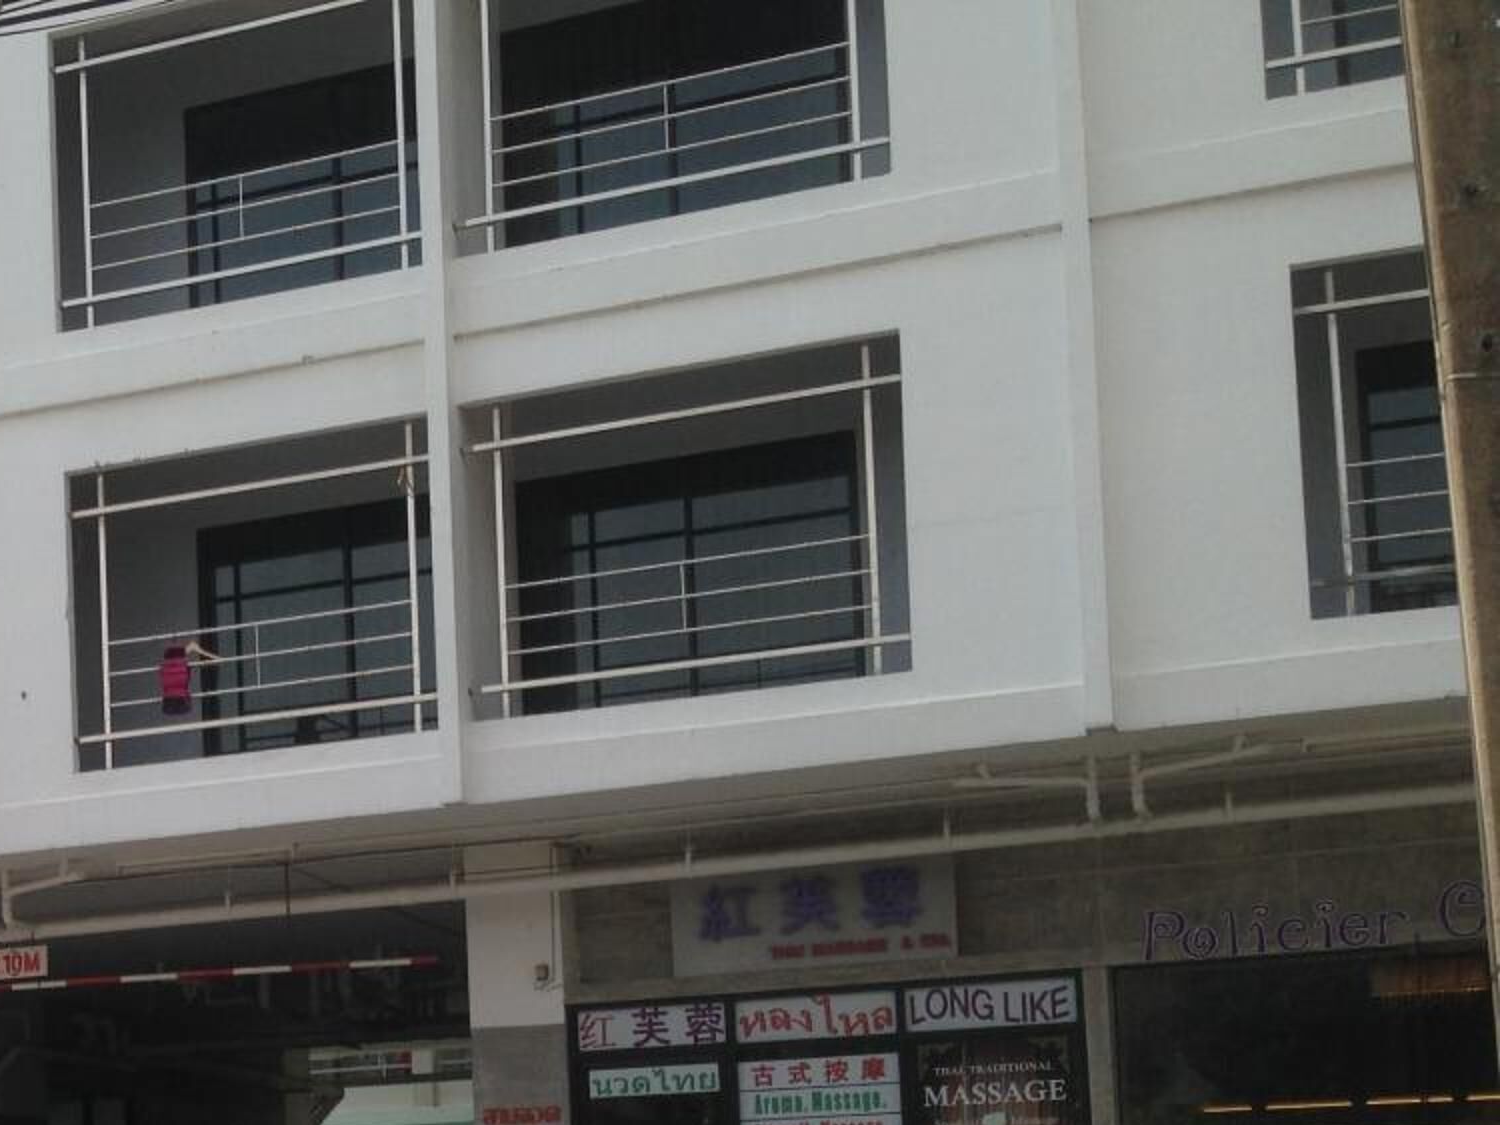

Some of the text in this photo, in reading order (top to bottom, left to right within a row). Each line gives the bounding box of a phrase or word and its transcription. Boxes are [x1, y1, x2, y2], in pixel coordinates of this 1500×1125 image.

[579, 1001, 726, 1049] 红芙蓉
[907, 985, 1071, 1025] LONG LIKE
[923, 1079, 1068, 1108] MASSAGE
